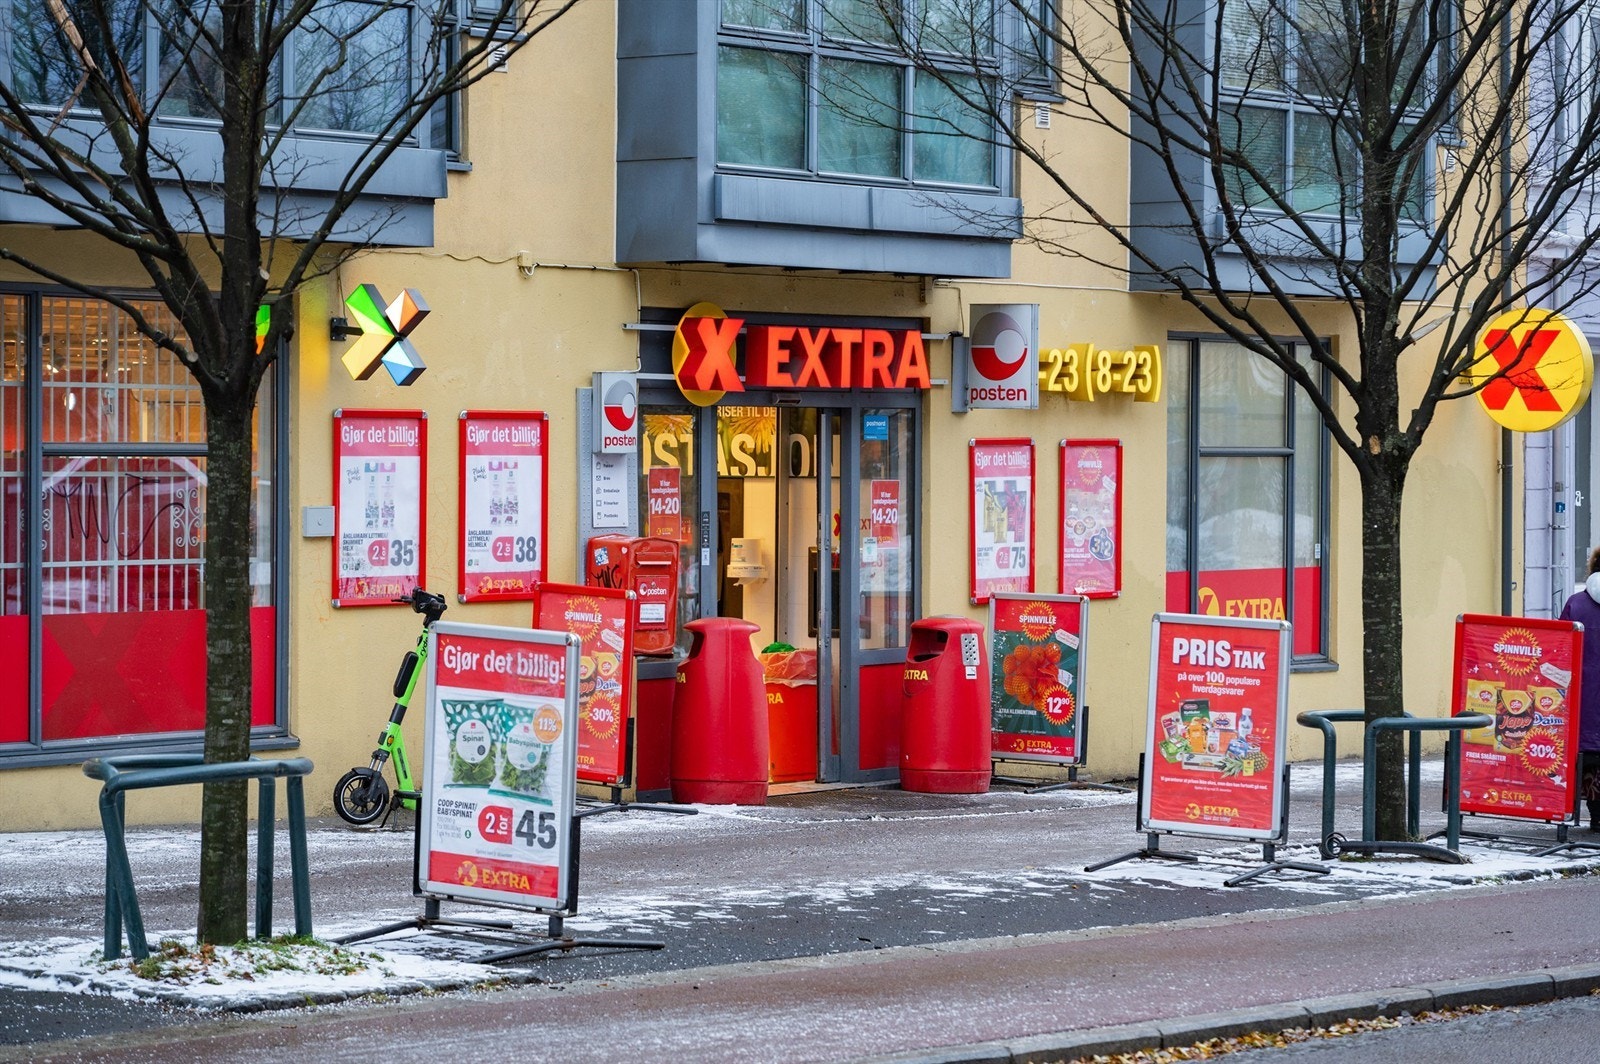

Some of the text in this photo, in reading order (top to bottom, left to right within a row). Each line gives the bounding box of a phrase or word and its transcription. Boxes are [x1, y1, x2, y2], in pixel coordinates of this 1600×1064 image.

[764, 326, 931, 389] EXTRA
[1038, 343, 1162, 403] -23 (8-23)
[970, 385, 1027, 404] posten
[717, 407, 745, 418] RISER
[747, 407, 760, 417] TIL
[342, 426, 419, 448] Gjør det billig!
[468, 426, 541, 447] Gjør det billig!
[604, 436, 636, 452] posten
[976, 452, 1030, 469] Gjør det billig!
[650, 497, 680, 515] 14-20
[872, 508, 898, 524] 14-20
[372, 545, 379, 560] 2
[390, 539, 414, 566] 35
[497, 542, 504, 556] 2
[515, 536, 537, 563] 38
[1011, 546, 1026, 569] 75
[647, 587, 668, 596] posten
[565, 611, 602, 623] SPINNVILLE
[1226, 598, 1286, 621] EXTRA
[1019, 615, 1056, 625] SPINNVILLE
[1172, 637, 1267, 671] PRIS TAK
[1493, 643, 1542, 657] SPINNVILLE
[444, 645, 566, 684] Gjør det billig!
[1178, 671, 1261, 687] på over 100 populære
[1192, 683, 1245, 697] hverdagsvarer
[590, 708, 614, 722] -30%
[1499, 715, 1532, 730] Japp
[1534, 711, 1565, 726] Daim
[538, 717, 558, 733] 11%
[463, 734, 485, 743] Spinat
[509, 737, 541, 749] Babyspinat
[1027, 740, 1051, 749] EXTRA
[1525, 743, 1557, 759] -30%
[576, 755, 595, 765] XTRA
[1501, 790, 1532, 802] EXTRA
[437, 798, 478, 812] COOP SPINAT/
[1203, 805, 1240, 817] EXTRA
[437, 808, 473, 819] BABYSPINAT
[485, 812, 496, 834] 2
[497, 815, 509, 835] for
[516, 809, 557, 849] 45
[482, 868, 531, 891] EXTRA
